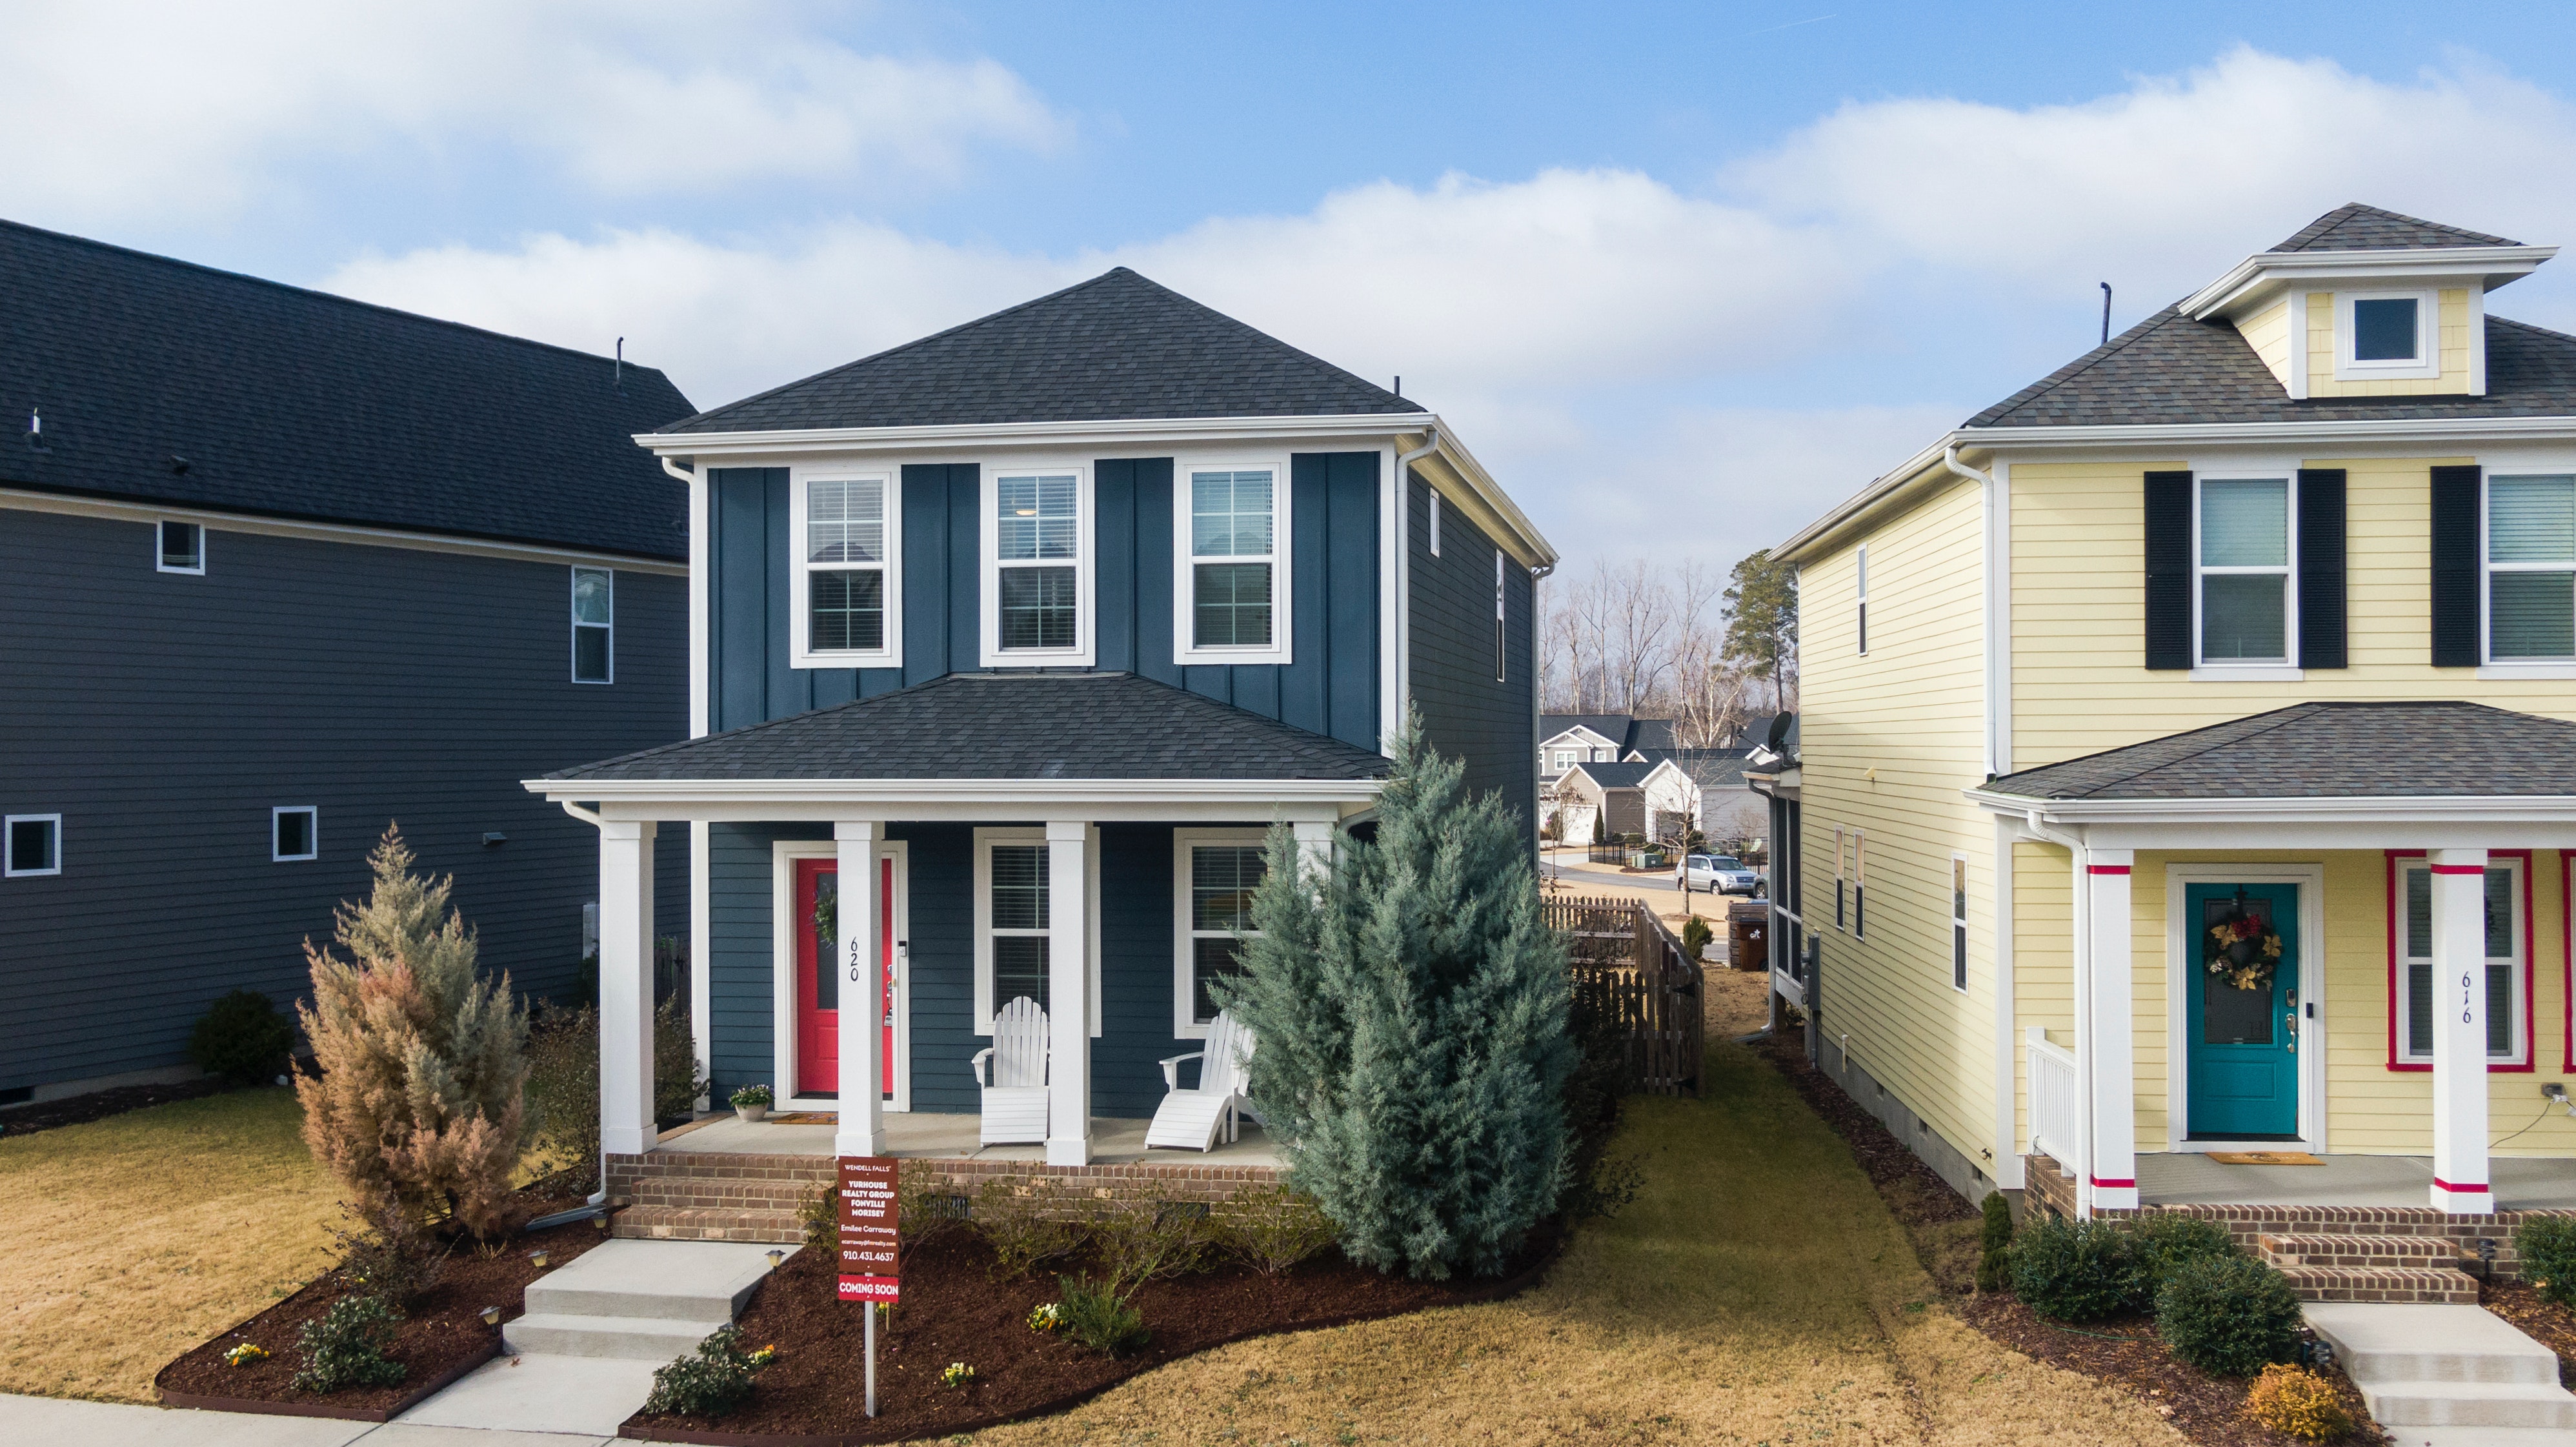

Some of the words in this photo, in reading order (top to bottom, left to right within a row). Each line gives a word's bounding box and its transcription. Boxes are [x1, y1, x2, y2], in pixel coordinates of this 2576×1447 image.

[2462, 971, 2471, 1024] 616
[848, 1180, 888, 1189] YURHOUSE
[841, 1189, 868, 1198] REALTY
[850, 1199, 885, 1208] FONVILLE
[851, 1209, 885, 1217] MORISEY
[841, 1224, 862, 1232] Emilee
[863, 1225, 896, 1235] Carraway
[843, 1250, 894, 1262] 910.431.4637
[839, 1282, 874, 1294] COMING
[874, 1284, 898, 1295] SOON
